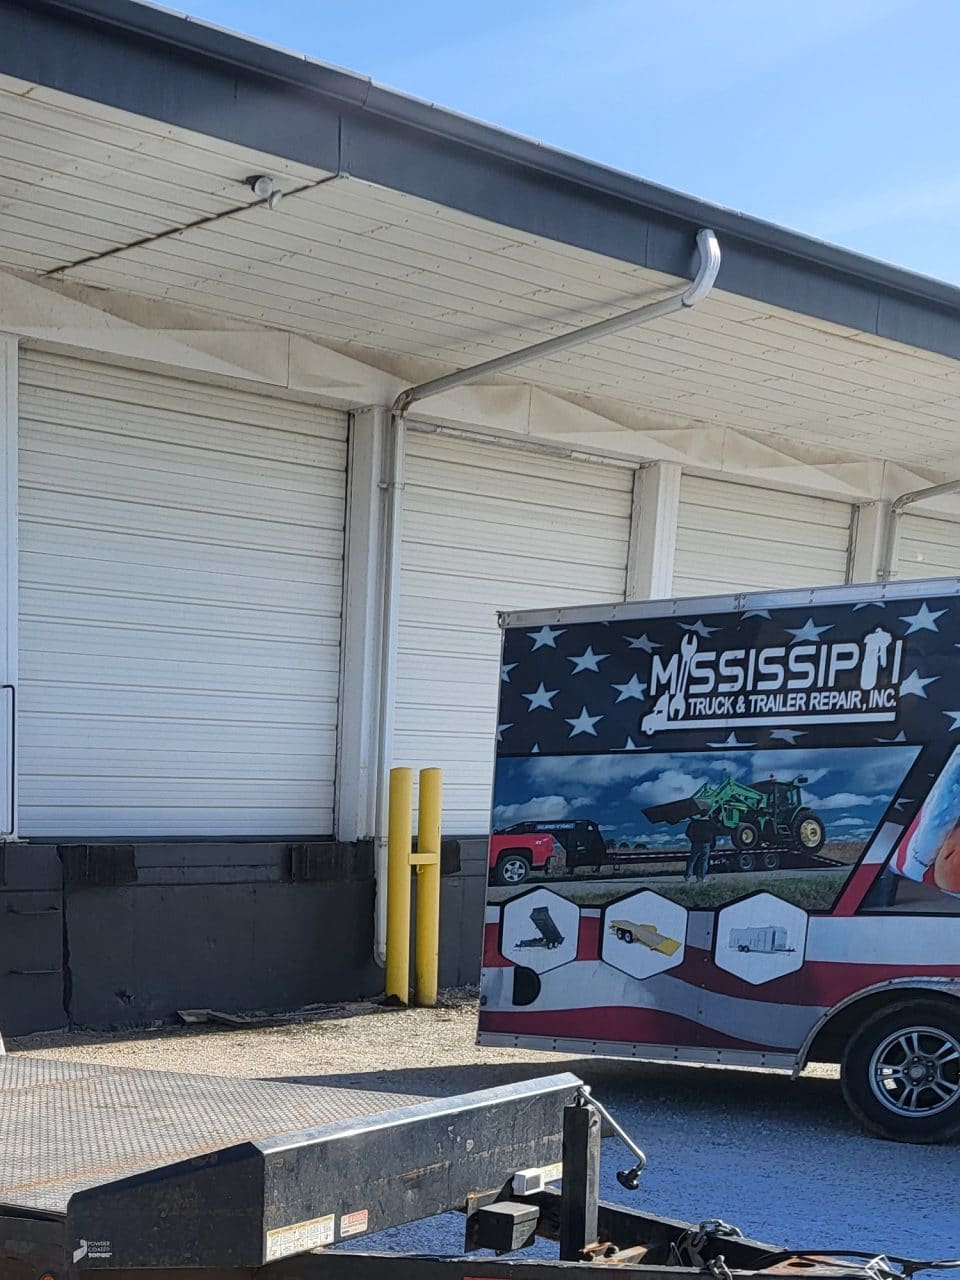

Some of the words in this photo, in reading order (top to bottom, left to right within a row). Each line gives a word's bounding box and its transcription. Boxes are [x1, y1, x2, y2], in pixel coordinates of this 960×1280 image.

[688, 698, 733, 715] TRUCK
[735, 698, 745, 713] &
[749, 692, 805, 713] TRAILER
[808, 690, 866, 711] REPAIR,
[868, 688, 897, 708] INC.
